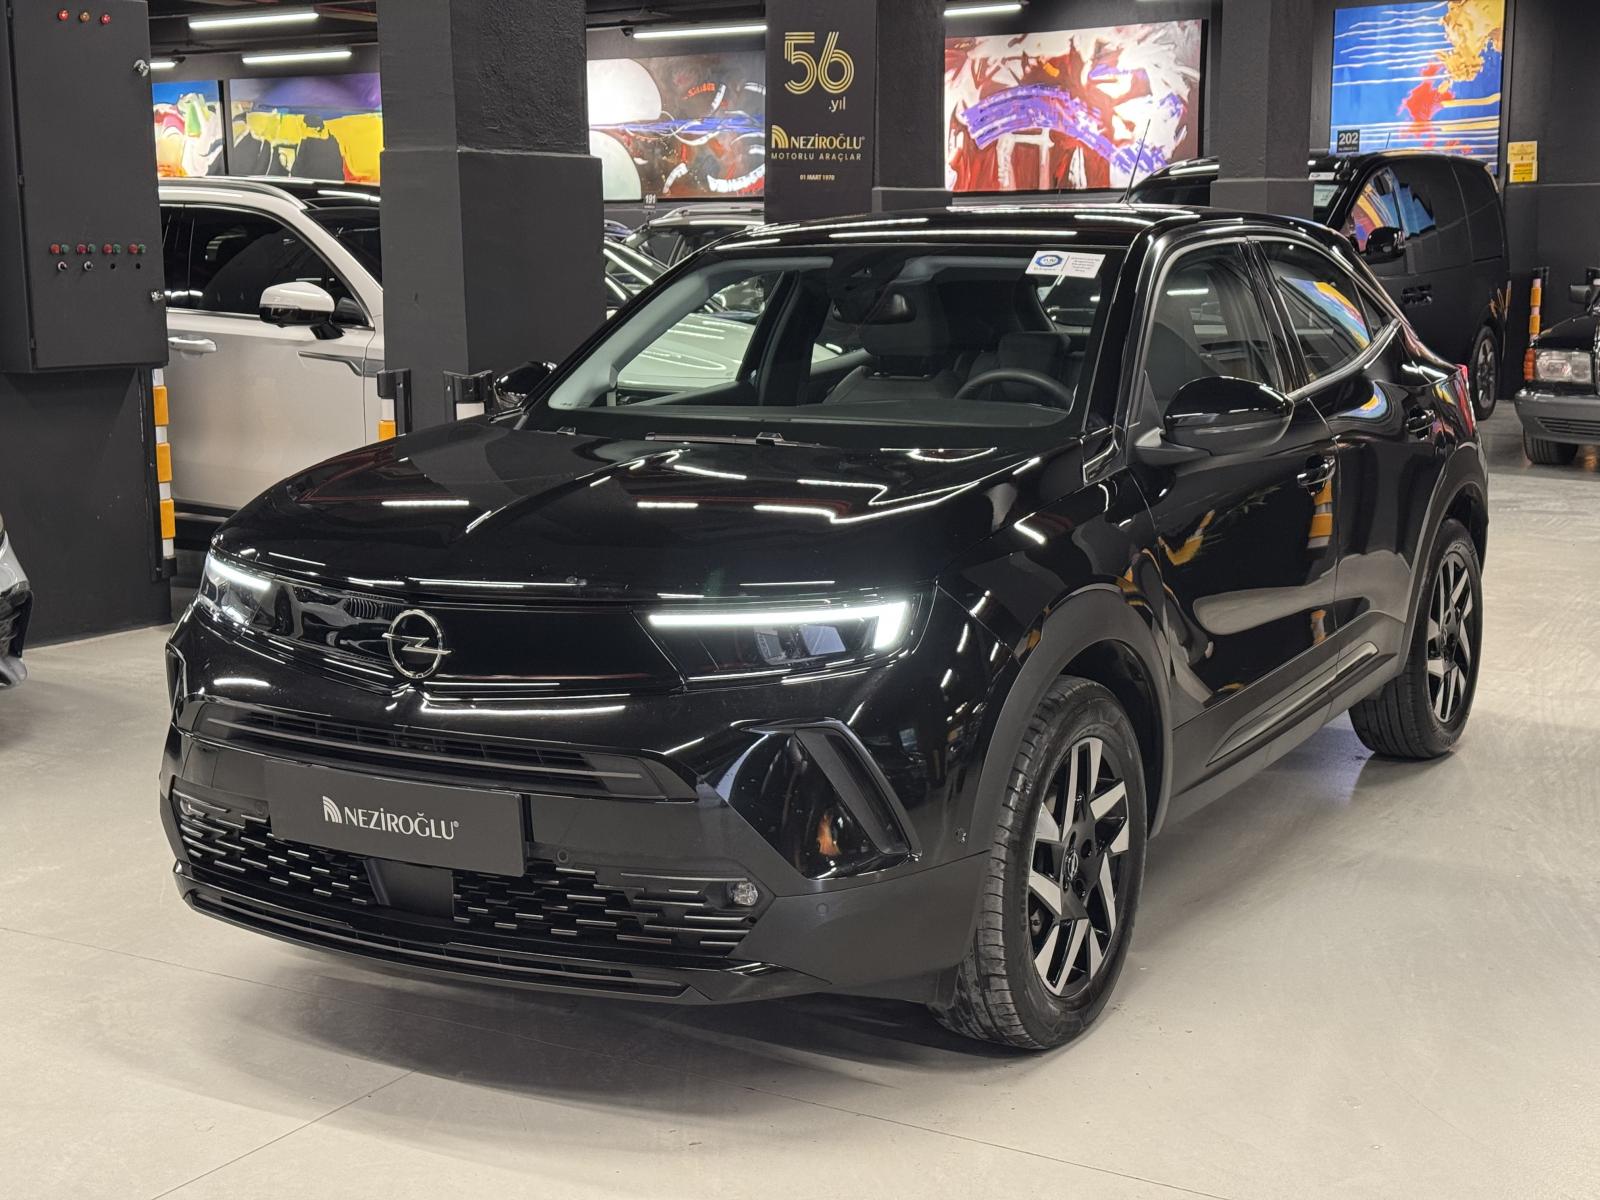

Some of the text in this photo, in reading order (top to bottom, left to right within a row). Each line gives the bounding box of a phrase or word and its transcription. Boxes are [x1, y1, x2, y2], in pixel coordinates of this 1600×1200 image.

[784, 31, 855, 95] 56
[1338, 132, 1359, 145] 202
[771, 152, 862, 163] MOTORLU ARAÇLAR
